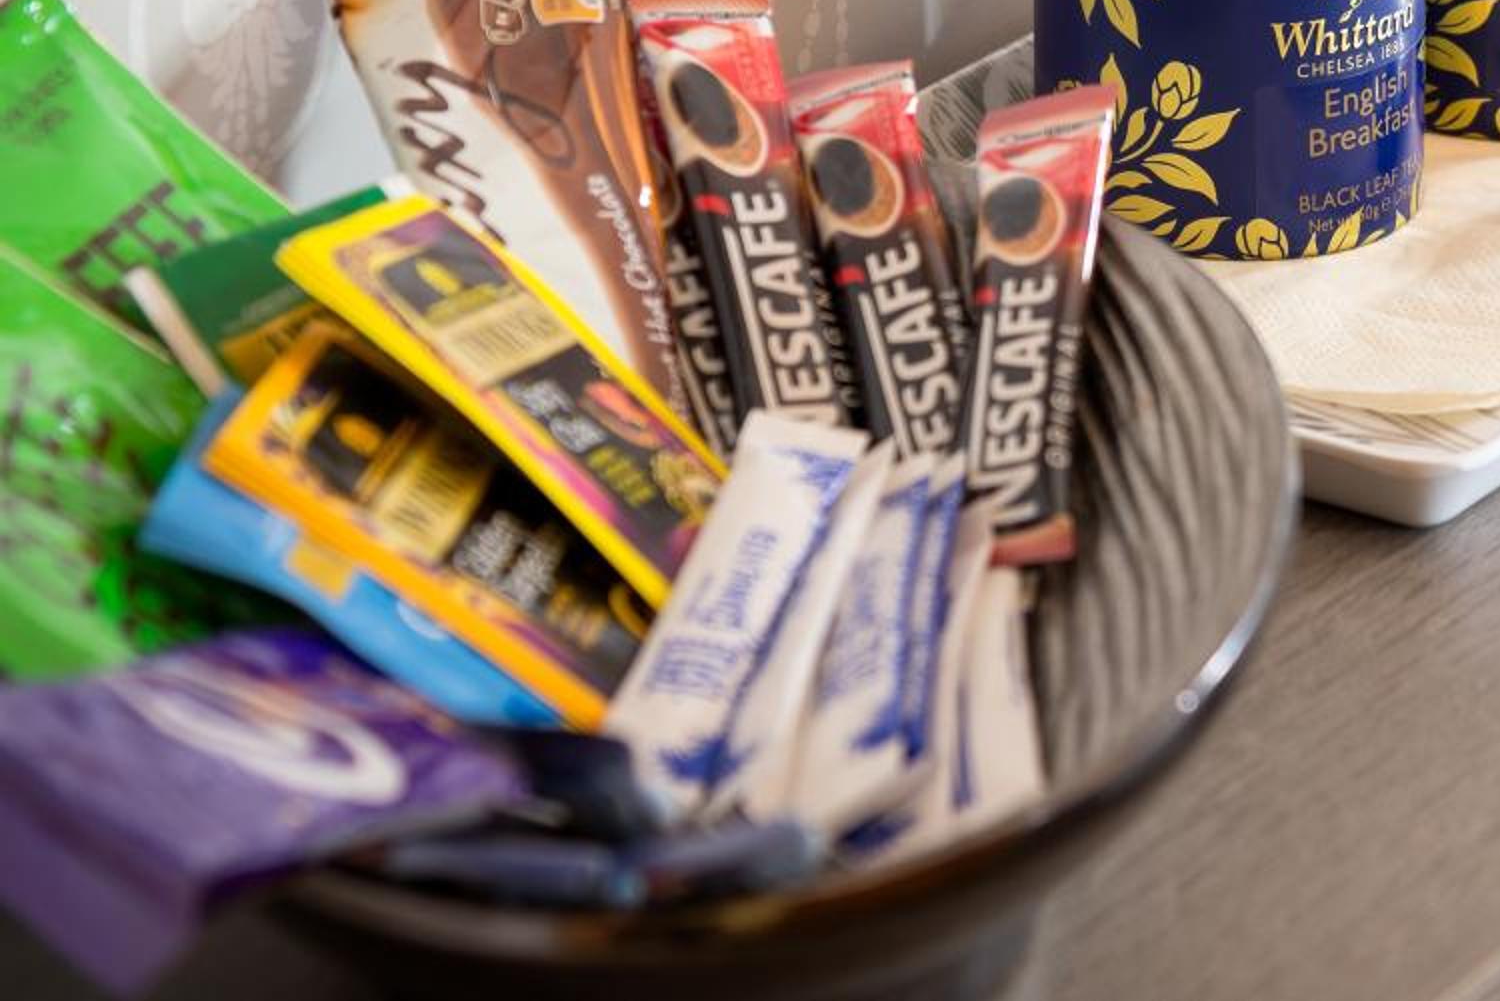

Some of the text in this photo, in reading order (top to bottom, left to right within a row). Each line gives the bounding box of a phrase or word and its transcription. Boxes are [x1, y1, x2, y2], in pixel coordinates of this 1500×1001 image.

[1297, 50, 1375, 79] CHELSEA
[1324, 62, 1409, 120] English
[1299, 184, 1362, 214] BLACK
[1365, 166, 1400, 198] LEAF
[1045, 322, 1084, 470] ORIGINAL
